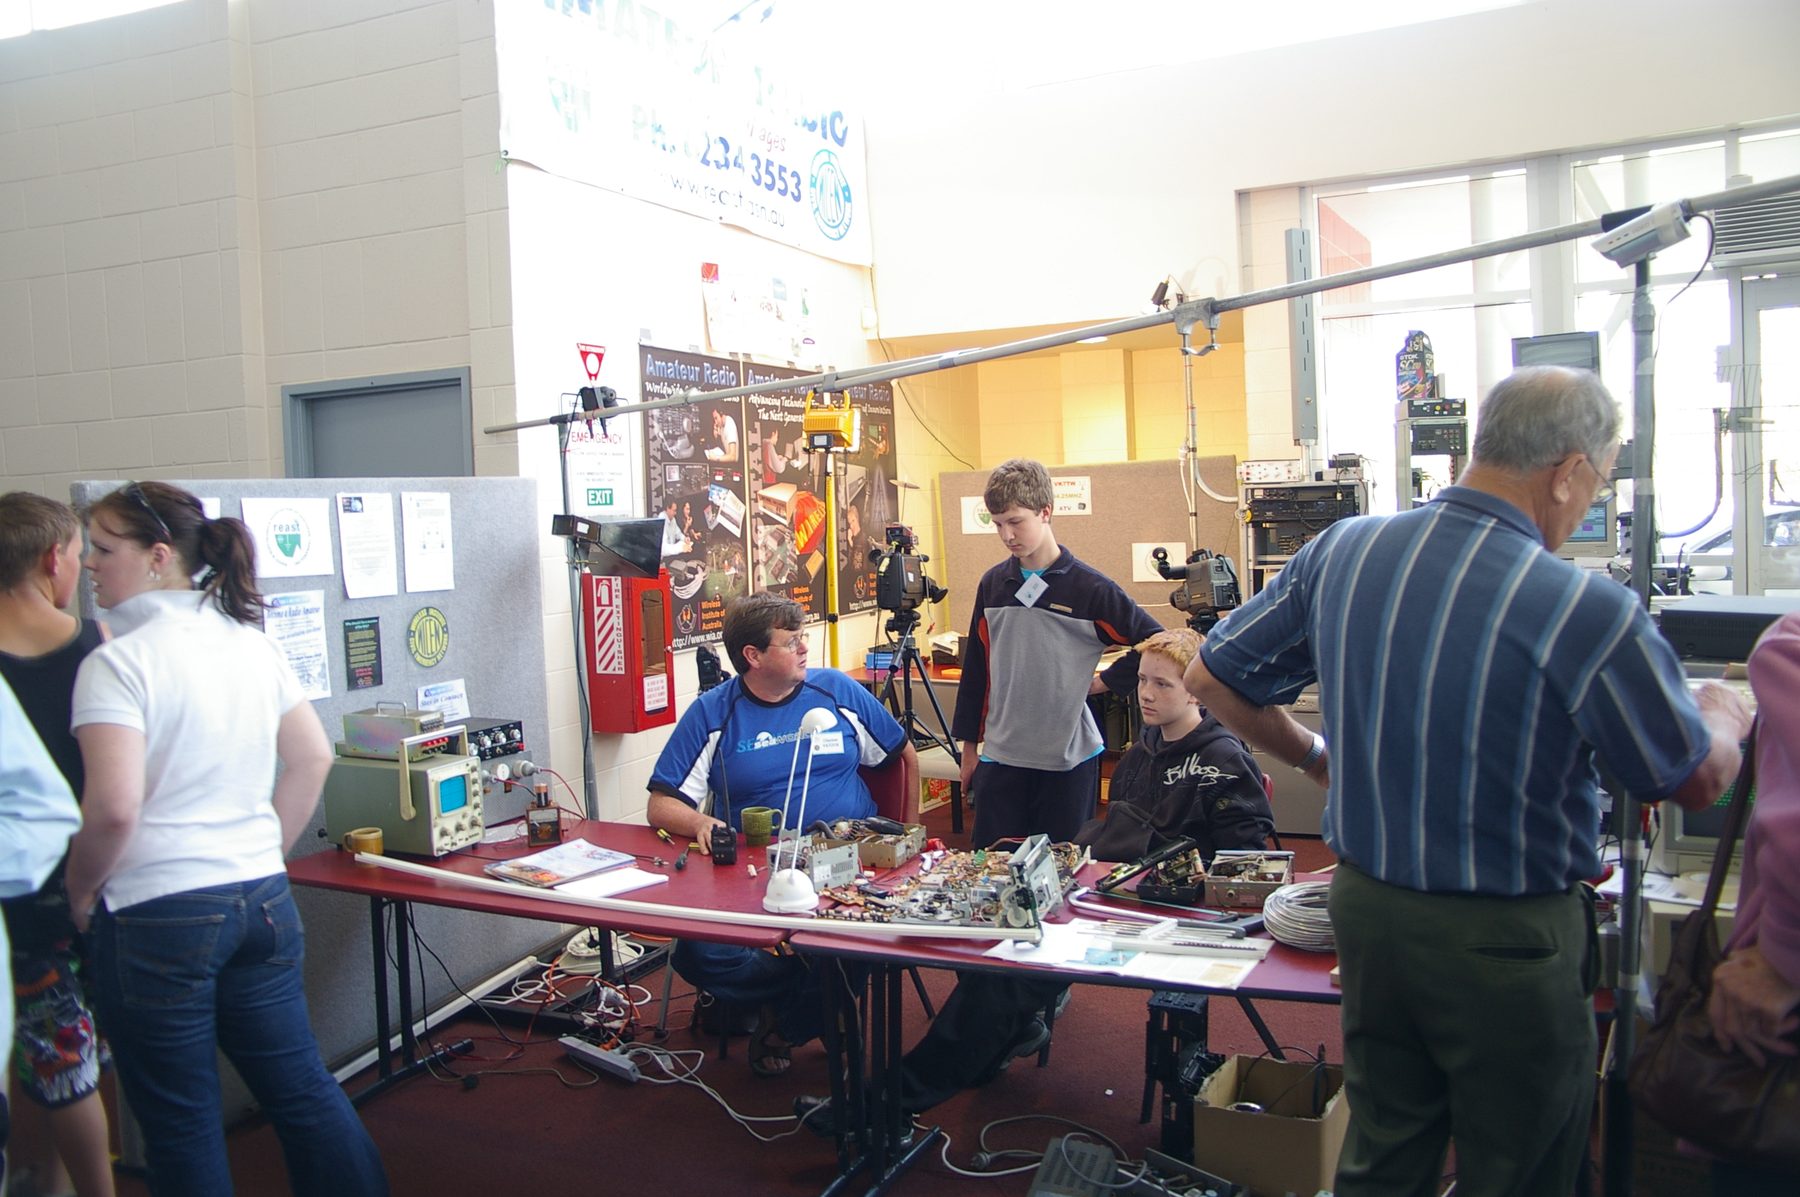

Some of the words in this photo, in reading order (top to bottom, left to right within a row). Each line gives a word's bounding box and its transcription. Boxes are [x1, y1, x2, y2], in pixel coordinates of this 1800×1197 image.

[750, 152, 802, 203] 3553
[646, 354, 700, 382] Amateur
[703, 362, 737, 387] Radio
[868, 383, 889, 401] Radio
[757, 408, 769, 420] The
[588, 490, 611, 505] EXIT
[273, 521, 301, 532] reast
[701, 600, 721, 609] Wireless
[701, 611, 720, 620] Institute
[702, 621, 722, 631] Australia
[615, 604, 623, 671] EXTINGUISHER
